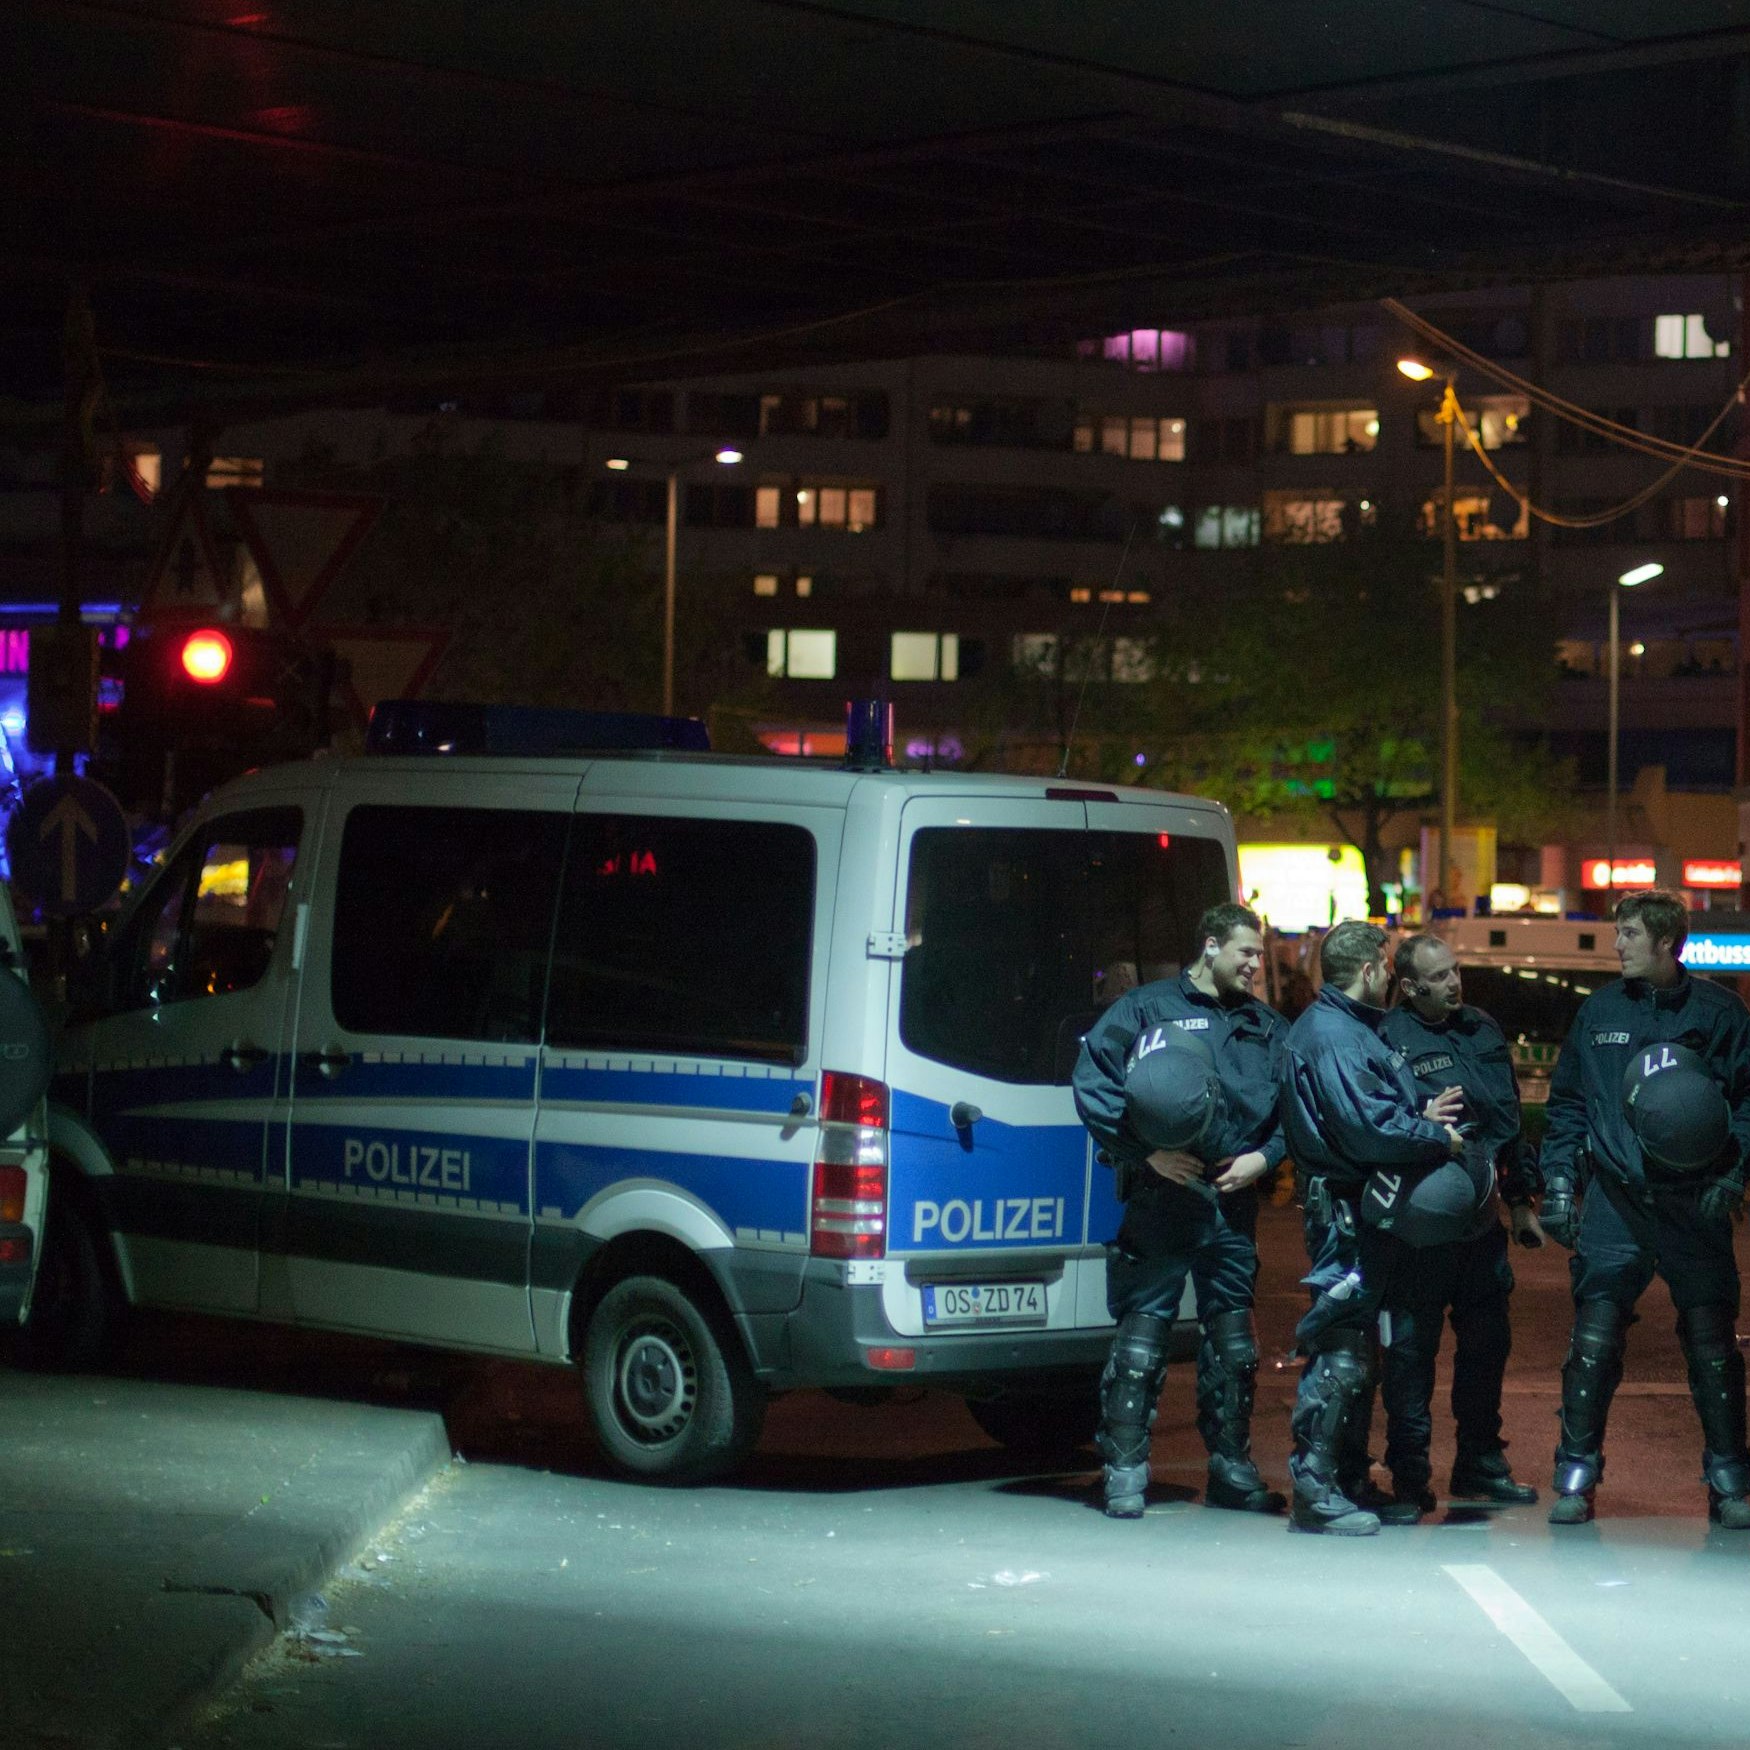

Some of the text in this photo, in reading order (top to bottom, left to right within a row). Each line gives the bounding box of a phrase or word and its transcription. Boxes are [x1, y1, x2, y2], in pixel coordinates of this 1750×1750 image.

[1173, 1018, 1209, 1031] LIZEI
[1413, 1055, 1454, 1077] POLIZEI
[344, 1138, 471, 1192] POLIZEI
[913, 1197, 1065, 1243] POLIZEI
[945, 1286, 1038, 1315] OS ZD 74
